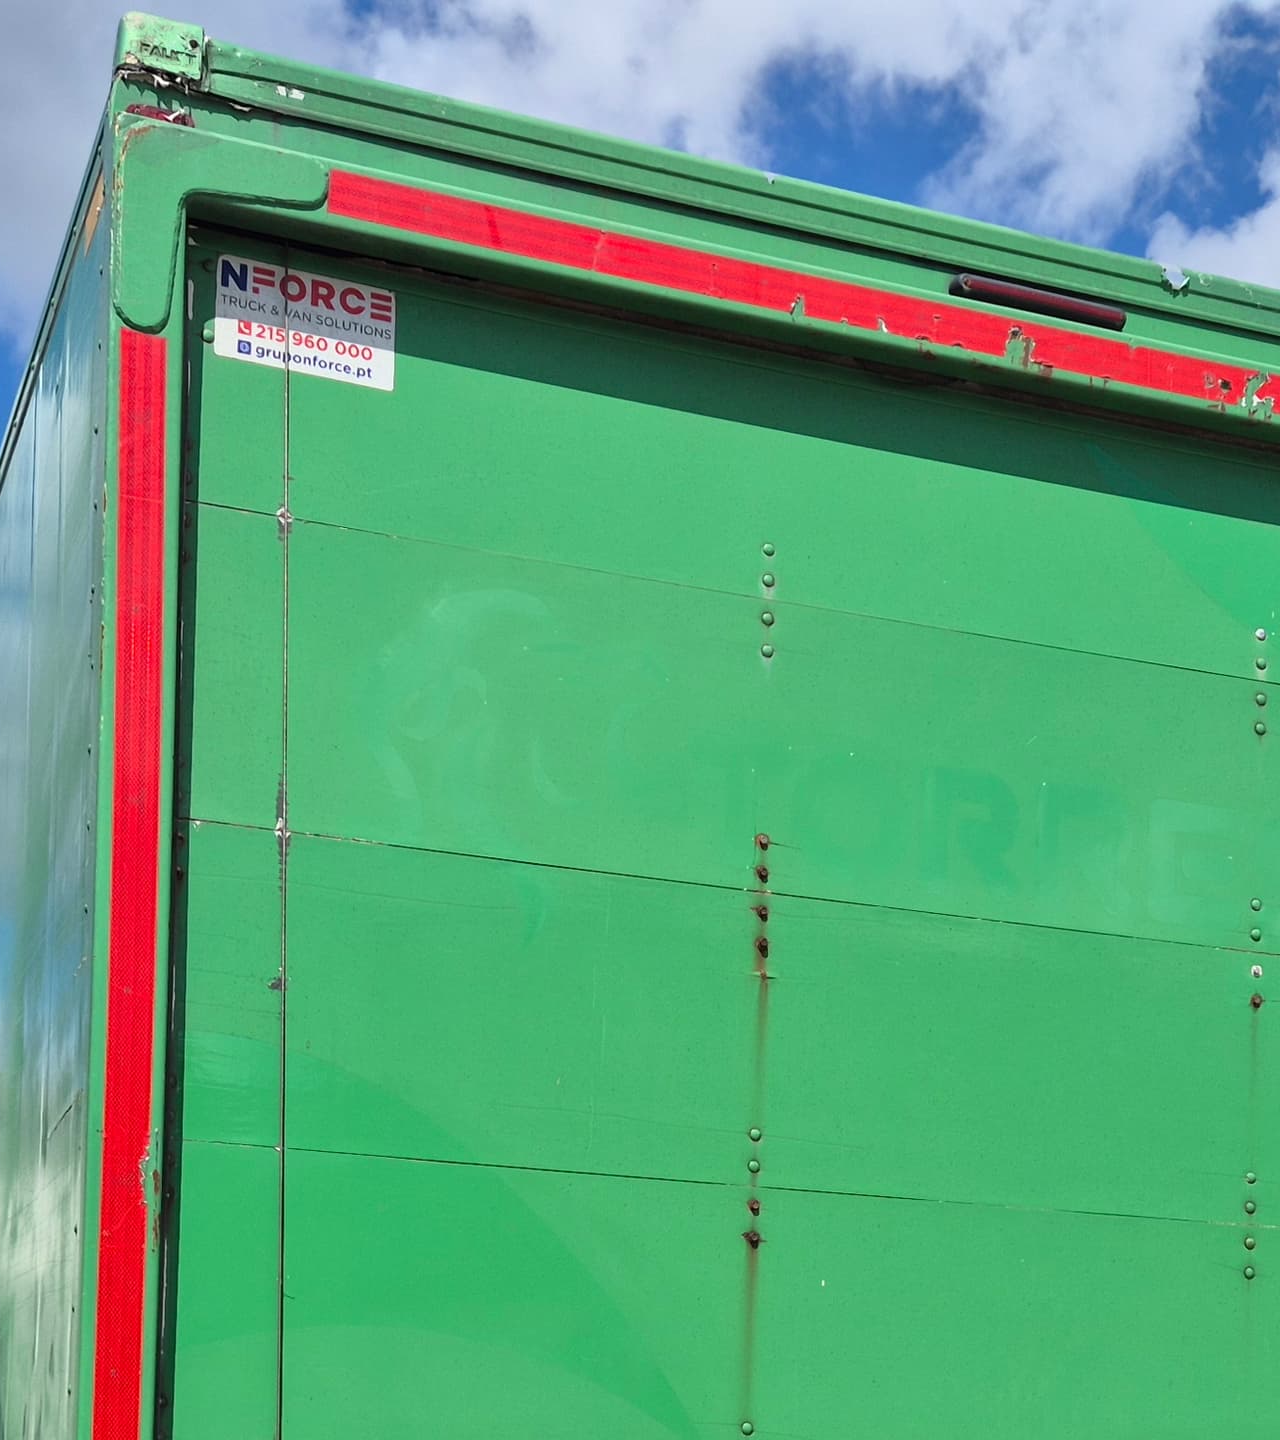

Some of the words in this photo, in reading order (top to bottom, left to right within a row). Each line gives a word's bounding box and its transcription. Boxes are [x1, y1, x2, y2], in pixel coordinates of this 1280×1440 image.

[221, 294, 267, 315] TRUCK
[270, 305, 280, 316] &
[285, 308, 312, 323] VAN
[315, 314, 392, 340] SOLUTIONS
[255, 324, 286, 343] 215
[291, 332, 328, 352] 960
[334, 341, 373, 361] 000
[255, 346, 372, 378] gruponforce.pt
